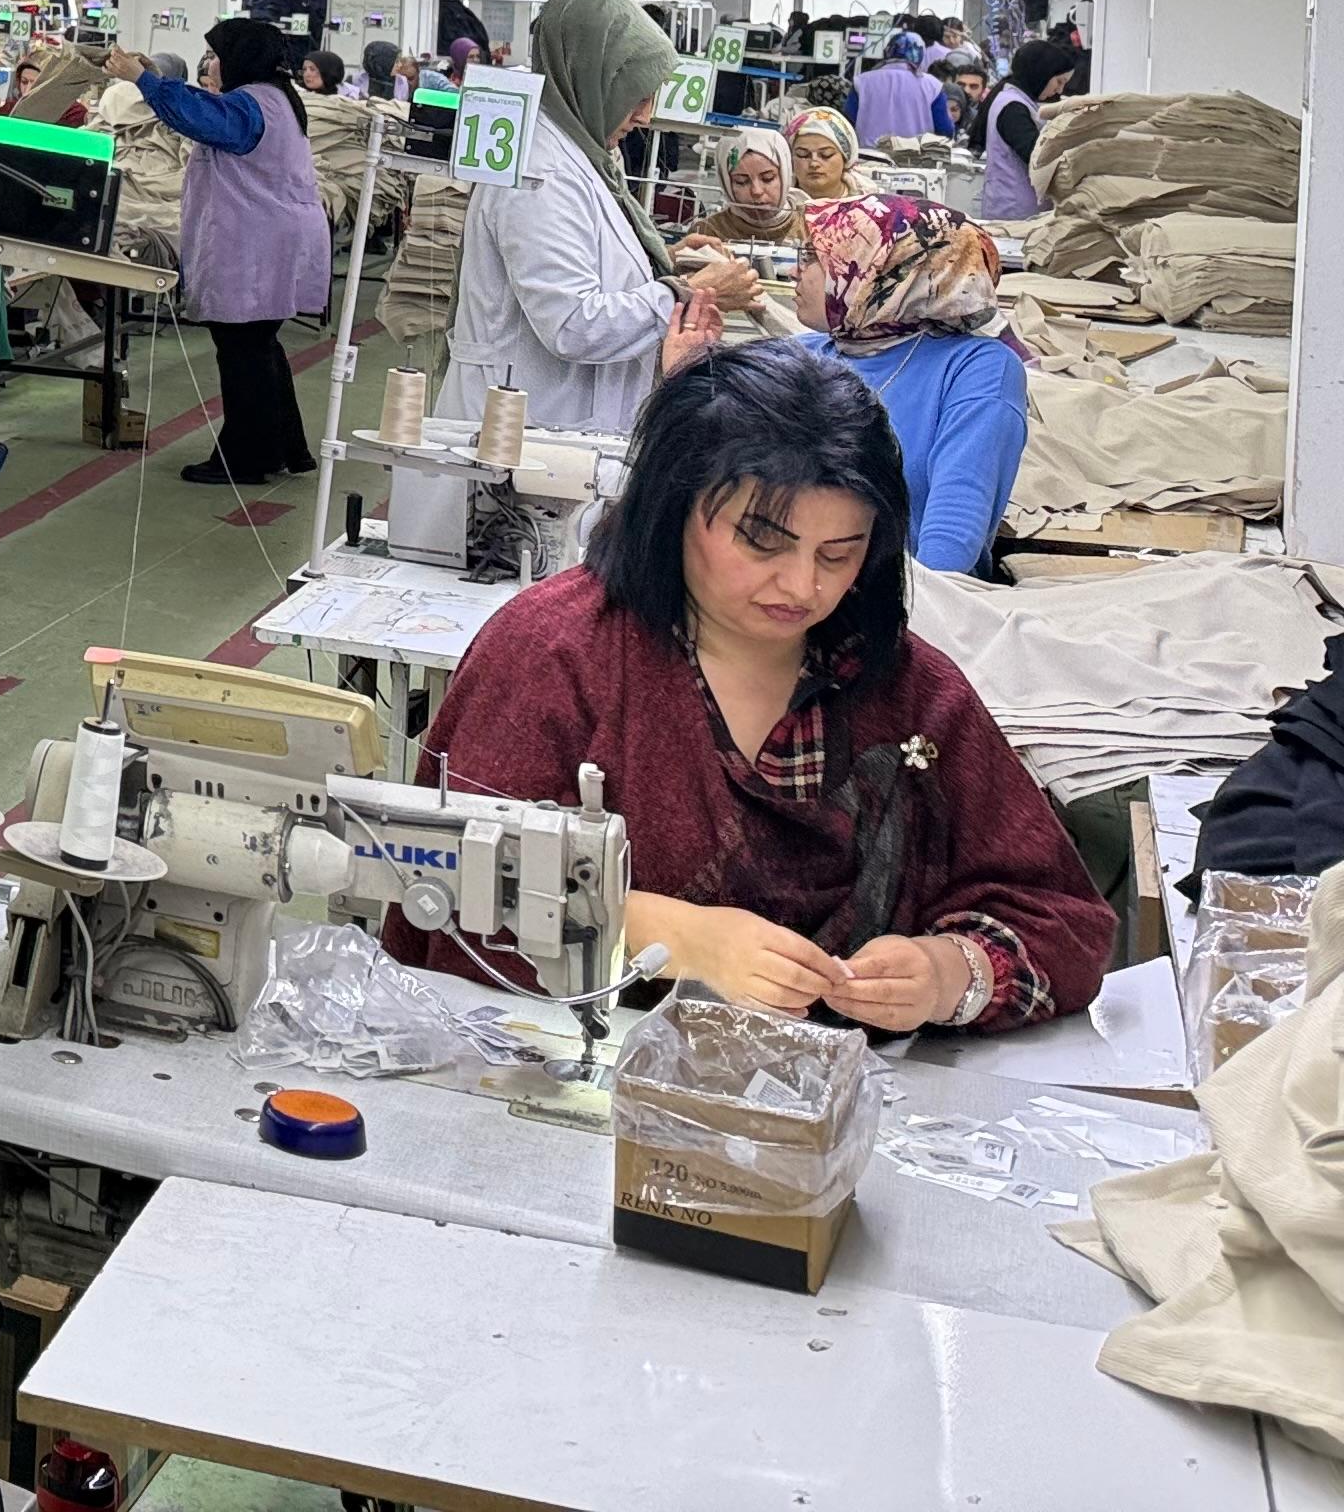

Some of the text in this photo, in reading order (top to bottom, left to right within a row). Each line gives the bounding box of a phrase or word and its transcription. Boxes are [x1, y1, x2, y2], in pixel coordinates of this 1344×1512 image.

[12, 19, 29, 36] 29
[100, 14, 118, 29] 20
[170, 14, 183, 29] 17
[293, 19, 306, 32] 26
[340, 21, 352, 33] 18
[382, 16, 393, 27] 19
[712, 36, 742, 65] 88
[822, 39, 834, 58] 5
[664, 72, 706, 113] 78
[458, 113, 515, 172] 13
[354, 841, 457, 871] JUKI
[122, 978, 212, 1009] JUK
[650, 1157, 689, 1183] 120
[620, 1191, 713, 1226] RENK NO
